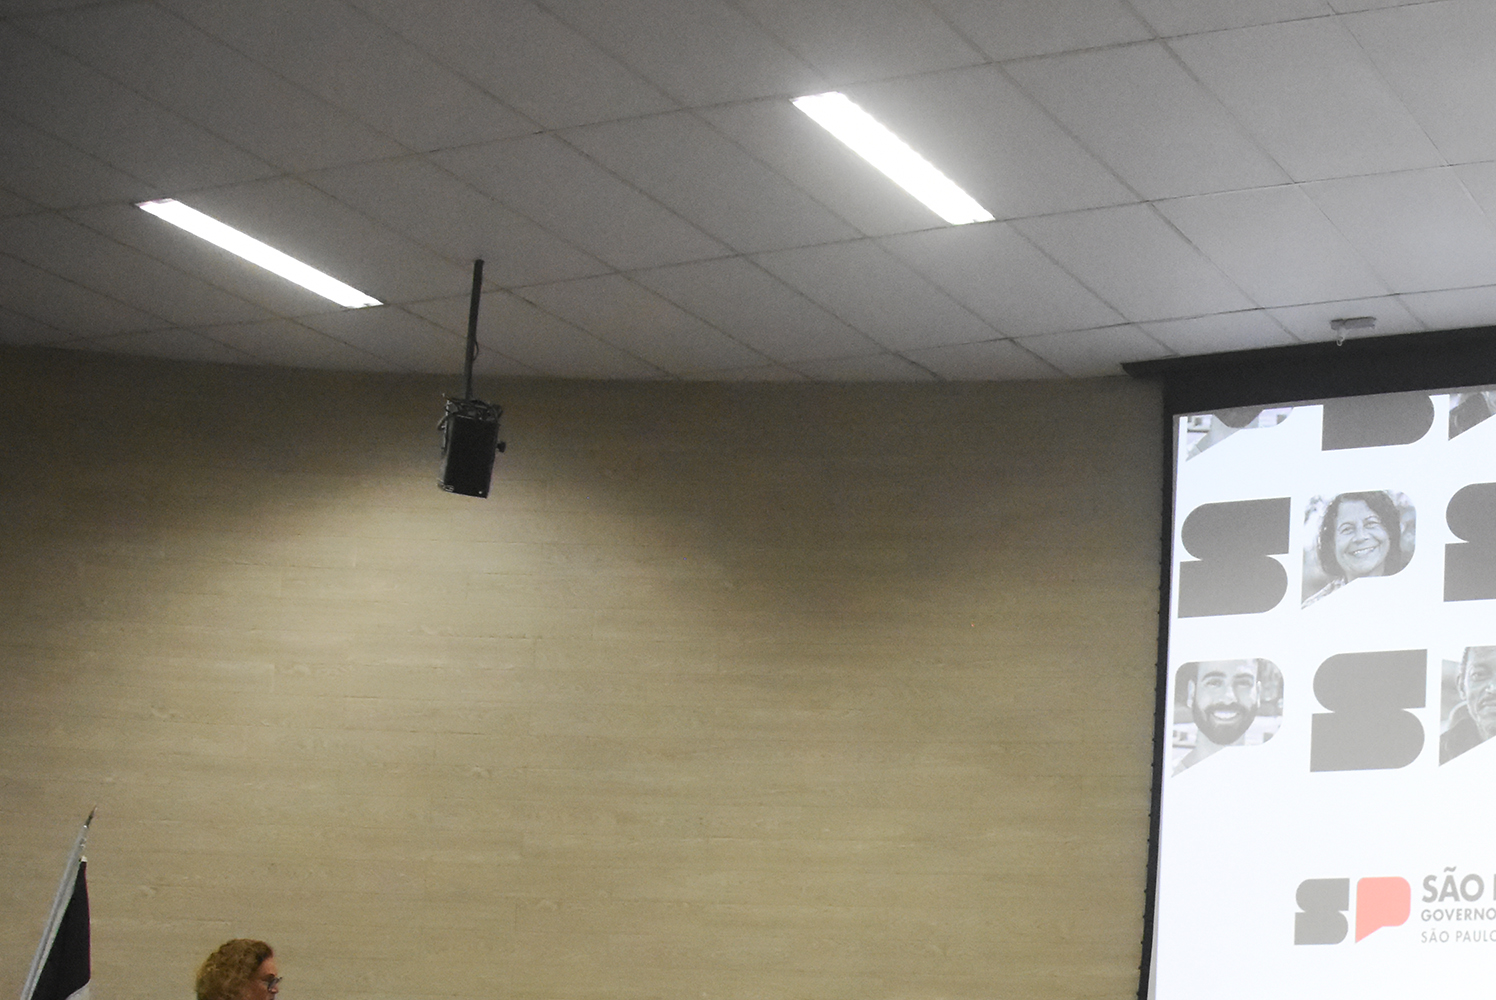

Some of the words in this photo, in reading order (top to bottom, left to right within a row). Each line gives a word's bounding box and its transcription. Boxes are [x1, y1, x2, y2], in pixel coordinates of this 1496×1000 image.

[1422, 866, 1484, 903] SÃO
[1421, 907, 1496, 922] GOVERNO
[1421, 928, 1449, 943] SÃO
